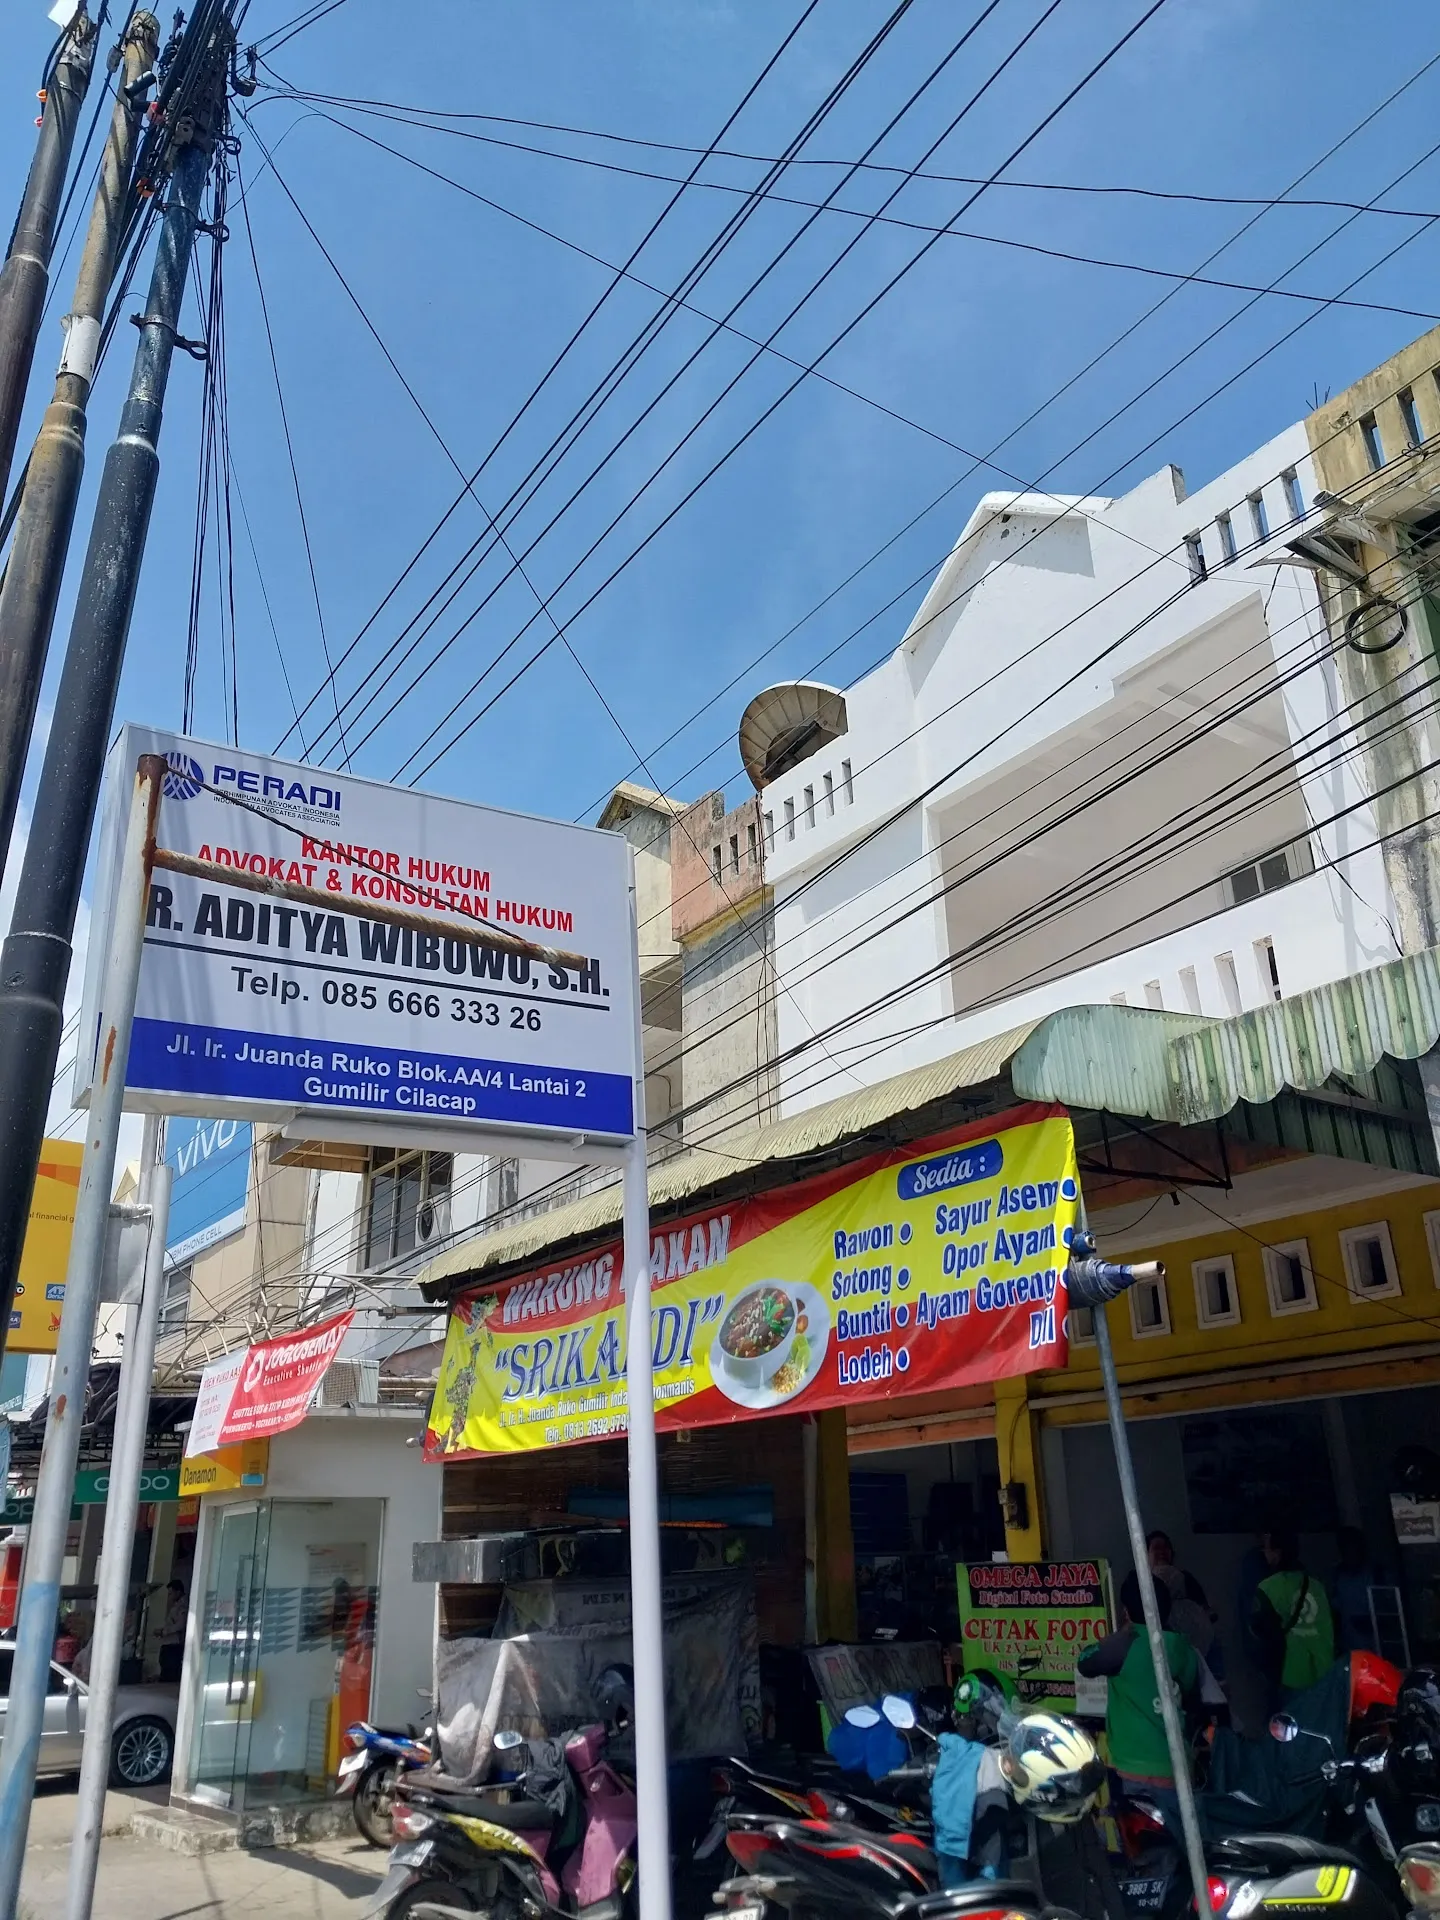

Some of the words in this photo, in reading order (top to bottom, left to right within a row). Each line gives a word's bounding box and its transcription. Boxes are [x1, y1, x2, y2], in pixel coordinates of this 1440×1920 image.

[213, 765, 341, 811] PERADI
[256, 805, 296, 818] ADVOCATES
[298, 814, 340, 827] ASSOCIATION
[268, 800, 301, 811] ADVOKAT
[303, 807, 340, 819] INDONESIA
[301, 837, 400, 875] KANTOR
[408, 857, 491, 892] HUKUM
[198, 844, 317, 887] ADVOKAT
[326, 868, 342, 891] &
[352, 872, 488, 918] KONSULTAN
[496, 900, 573, 933] HUKUM
[193, 893, 348, 957] ADITYA
[359, 920, 539, 990] WIBOWO,
[231, 966, 309, 1005] Telp.
[322, 980, 377, 1010] 085
[388, 990, 440, 1018] 666
[450, 998, 500, 1026] 333
[510, 1006, 542, 1031] 26
[166, 1034, 195, 1056] Jl.
[205, 1038, 227, 1058] Ir.
[235, 1042, 324, 1069] Juanda
[331, 1053, 391, 1077] Ruko
[398, 1060, 503, 1088] Blok.AA/4
[509, 1073, 569, 1096] Lantai
[575, 1080, 586, 1097] 2
[304, 1076, 389, 1102] Gumilir
[395, 1086, 476, 1114] Cilacap
[177, 1120, 237, 1176] vivo
[913, 1155, 973, 1194] Sedia
[36, 1212, 68, 1222] financial
[935, 1199, 991, 1236] Sayur
[997, 1179, 1059, 1217] Asem
[834, 1224, 893, 1259] Rawon
[942, 1240, 988, 1279] Opor
[994, 1222, 1057, 1266] Ayam
[503, 1253, 614, 1325] WARUNG
[620, 1214, 732, 1293] AKAN
[832, 1265, 892, 1300] Sotong
[916, 1288, 970, 1329] Ayam
[976, 1268, 1057, 1311] Goreng
[837, 1300, 892, 1341] Buntil
[263, 1369, 293, 1386] Executive
[838, 1344, 893, 1385] Lodeh
[527, 1404, 555, 1422] Juanda
[557, 1401, 576, 1416] Ruko
[578, 1393, 608, 1413] Gumilir
[544, 1427, 561, 1442] Telp.
[564, 1422, 584, 1441] 0813
[587, 1418, 608, 1436] 2692
[183, 1467, 217, 1486] Danamon
[970, 1564, 1042, 1588] OMEGA
[1044, 1562, 1100, 1586] JAYA
[979, 1590, 1018, 1607] Digital
[1020, 1590, 1049, 1605] Foto
[1051, 1589, 1093, 1605] Studio
[964, 1618, 1039, 1640] CETAK
[1046, 1618, 1109, 1641] FOTO
